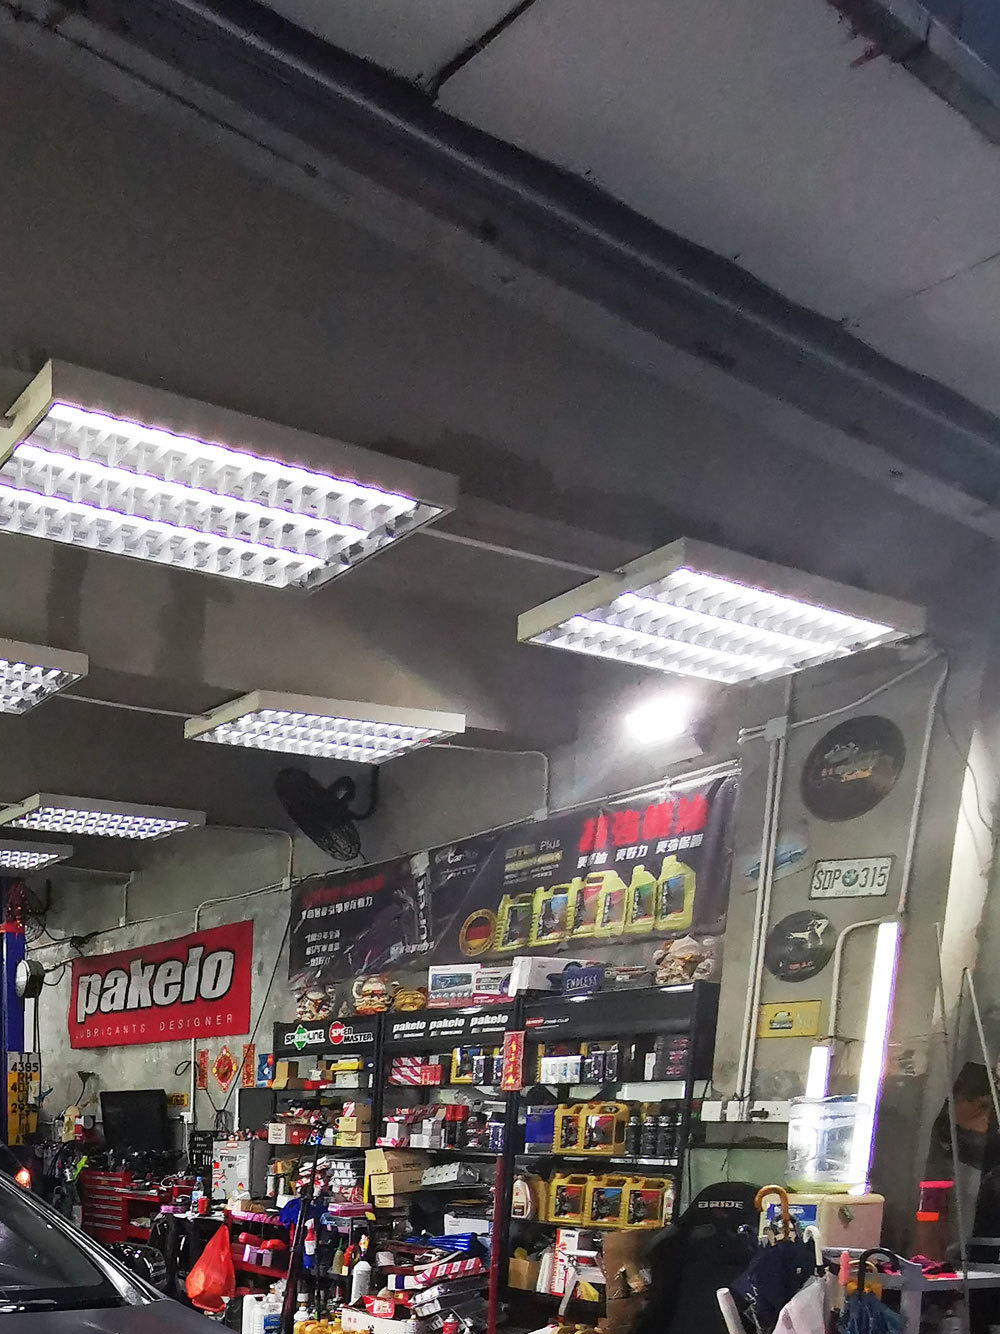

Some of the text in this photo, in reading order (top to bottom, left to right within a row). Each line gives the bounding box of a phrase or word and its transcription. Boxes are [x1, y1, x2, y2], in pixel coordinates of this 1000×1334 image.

[813, 865, 889, 890] SDP 315
[76, 946, 235, 1024] pakelo
[566, 974, 598, 989] ENDLESS
[76, 1014, 233, 1039] UBRICANTS DESIGNER
[392, 1020, 426, 1033] pakelo
[428, 1017, 465, 1030] pakelo
[469, 1014, 509, 1027] pakelo
